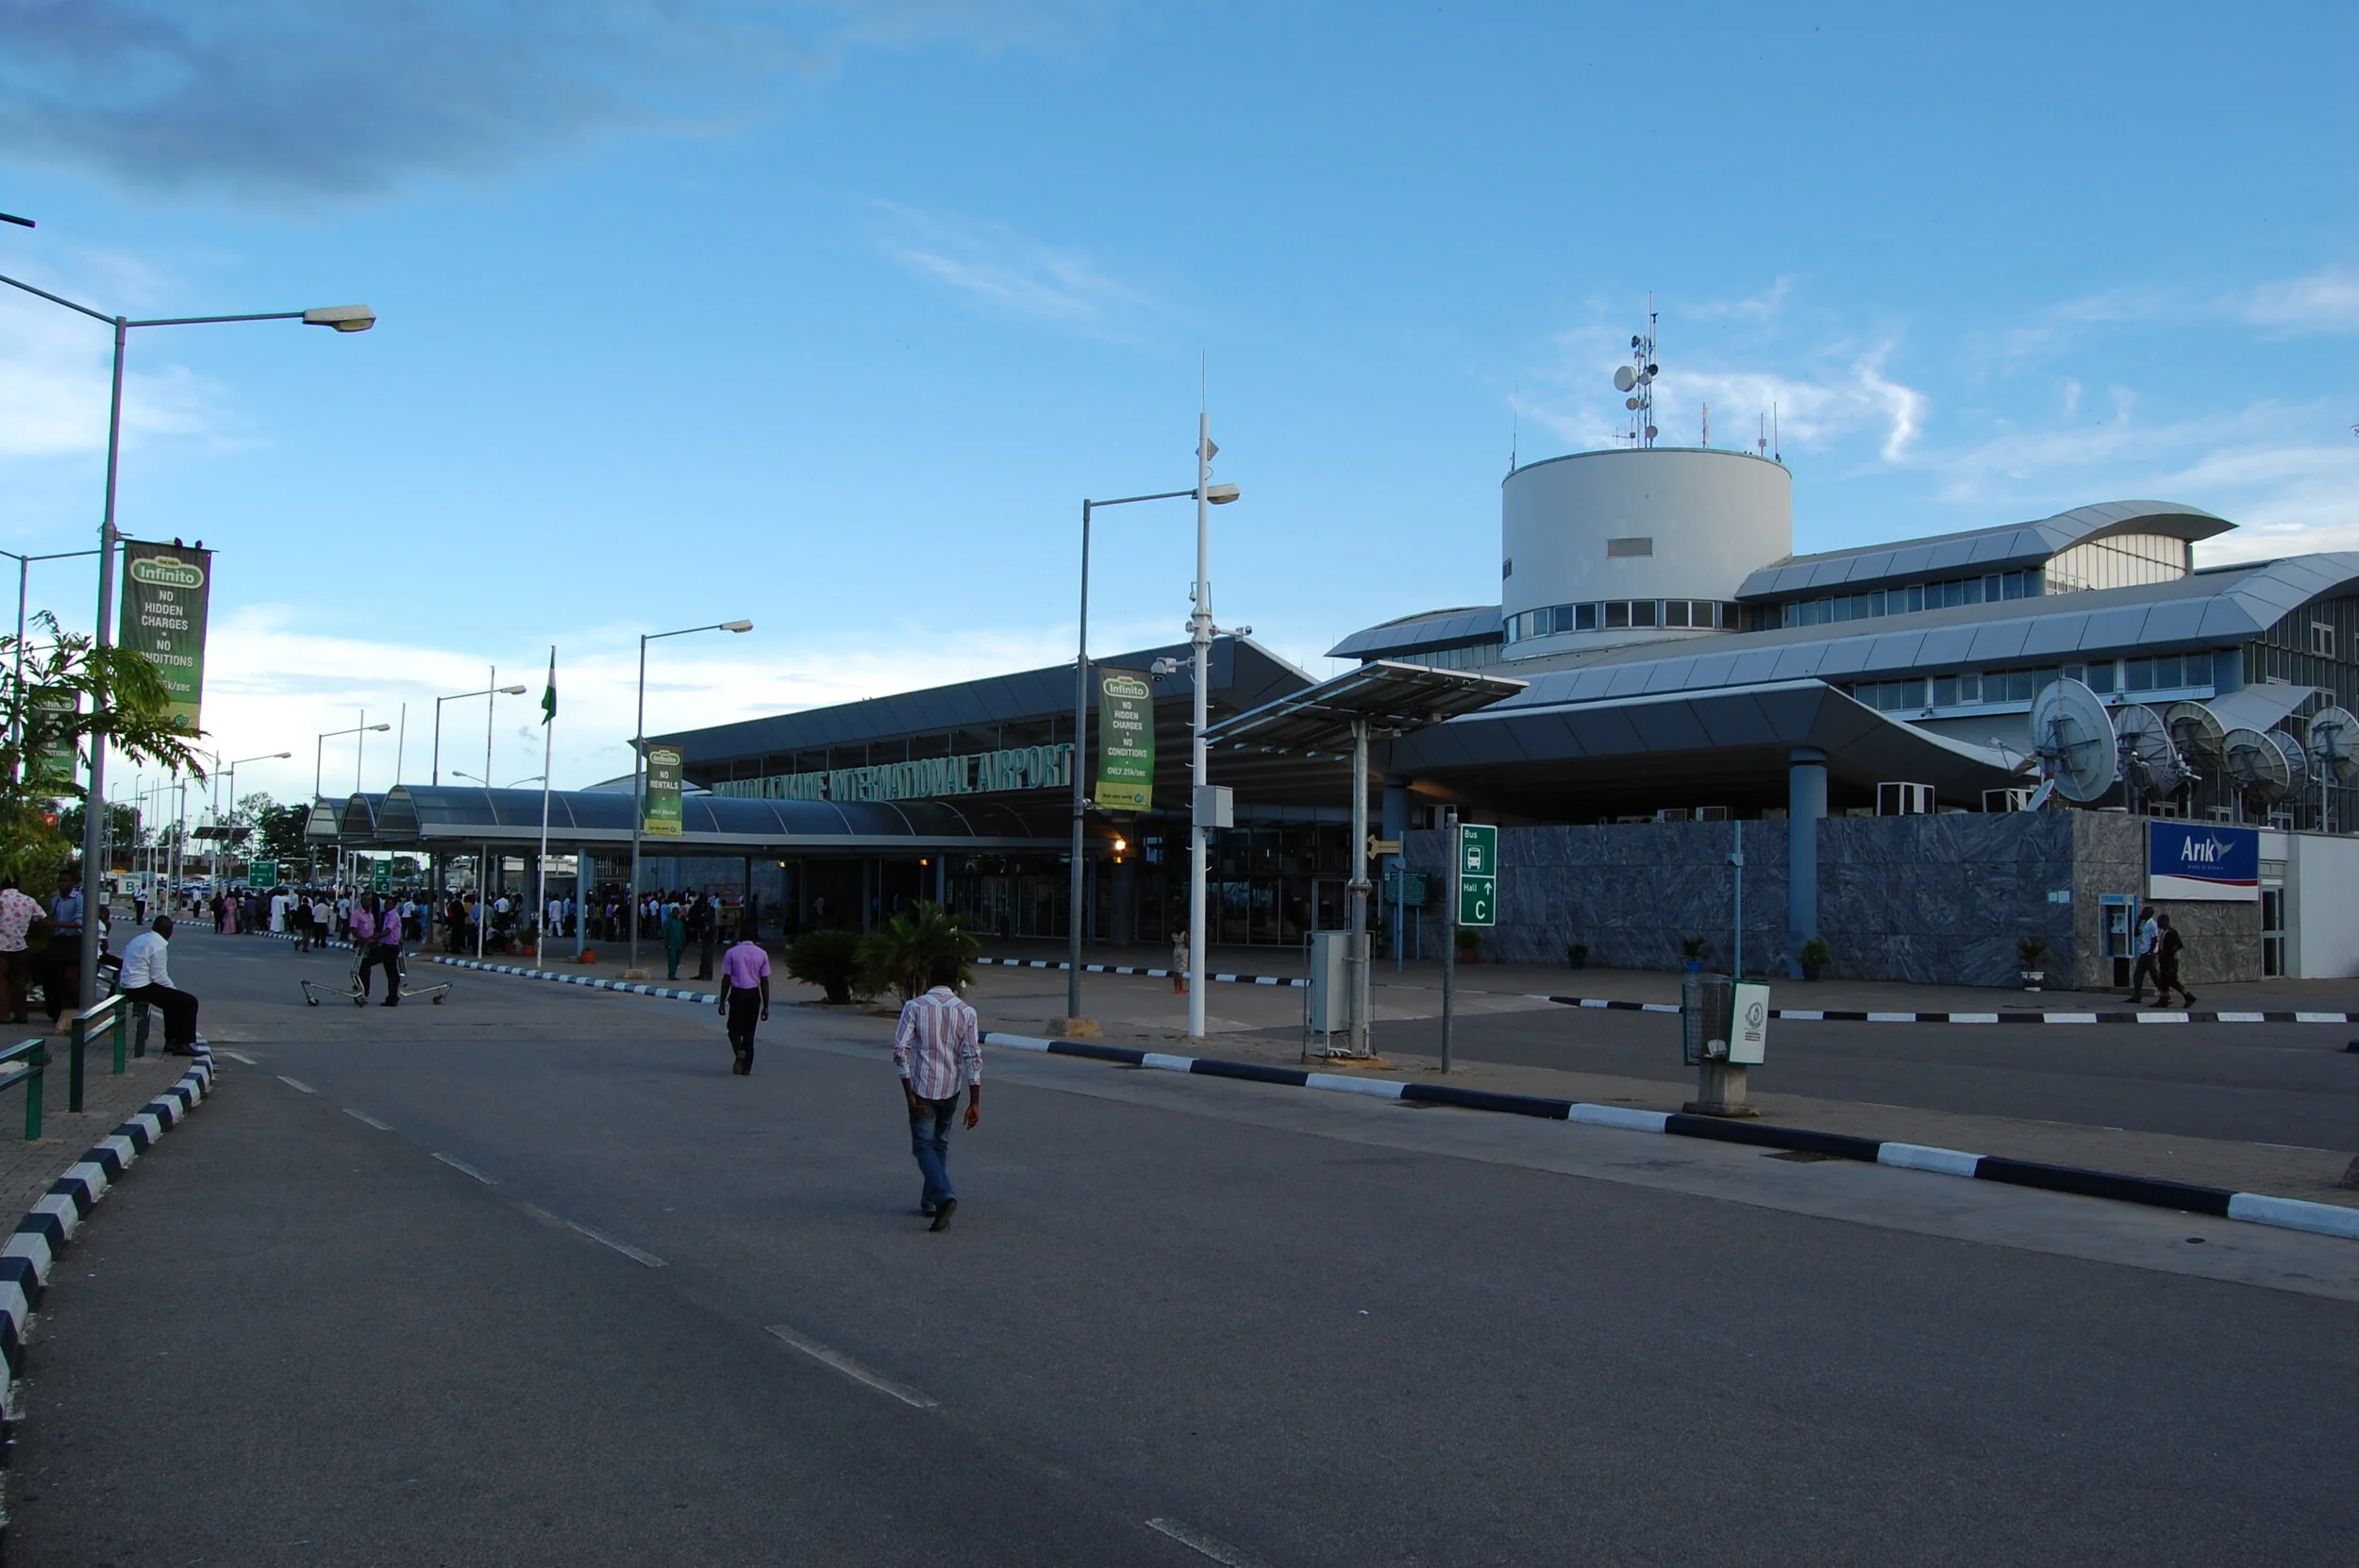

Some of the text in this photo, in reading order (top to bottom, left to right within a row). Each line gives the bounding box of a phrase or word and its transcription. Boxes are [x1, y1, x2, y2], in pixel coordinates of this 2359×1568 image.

[141, 566, 194, 584] Infinito
[159, 590, 174, 602] NO
[144, 602, 183, 616] HIDDEN
[142, 615, 189, 630] CHARGES
[157, 640, 171, 651] NO
[140, 652, 193, 667] NDITIONS
[1110, 683, 1145, 696] Infinito
[1122, 701, 1132, 709] NO
[1114, 710, 1139, 721] HIDDEN
[1113, 720, 1143, 731] CHARGES
[1123, 738, 1133, 747] NO
[1107, 747, 1147, 759] CONDITIONS
[660, 771, 669, 779] NO
[829, 755, 971, 801] INTERNATIONAL
[977, 742, 1075, 792] AIRPORT
[1107, 766, 1123, 776] ONLY
[649, 780, 678, 790] RENTALS
[1464, 829, 1478, 839] Bus
[2181, 835, 2215, 862] Arik
[125, 881, 135, 892] B
[1464, 883, 1478, 892] Hall
[1475, 900, 1485, 920] C
